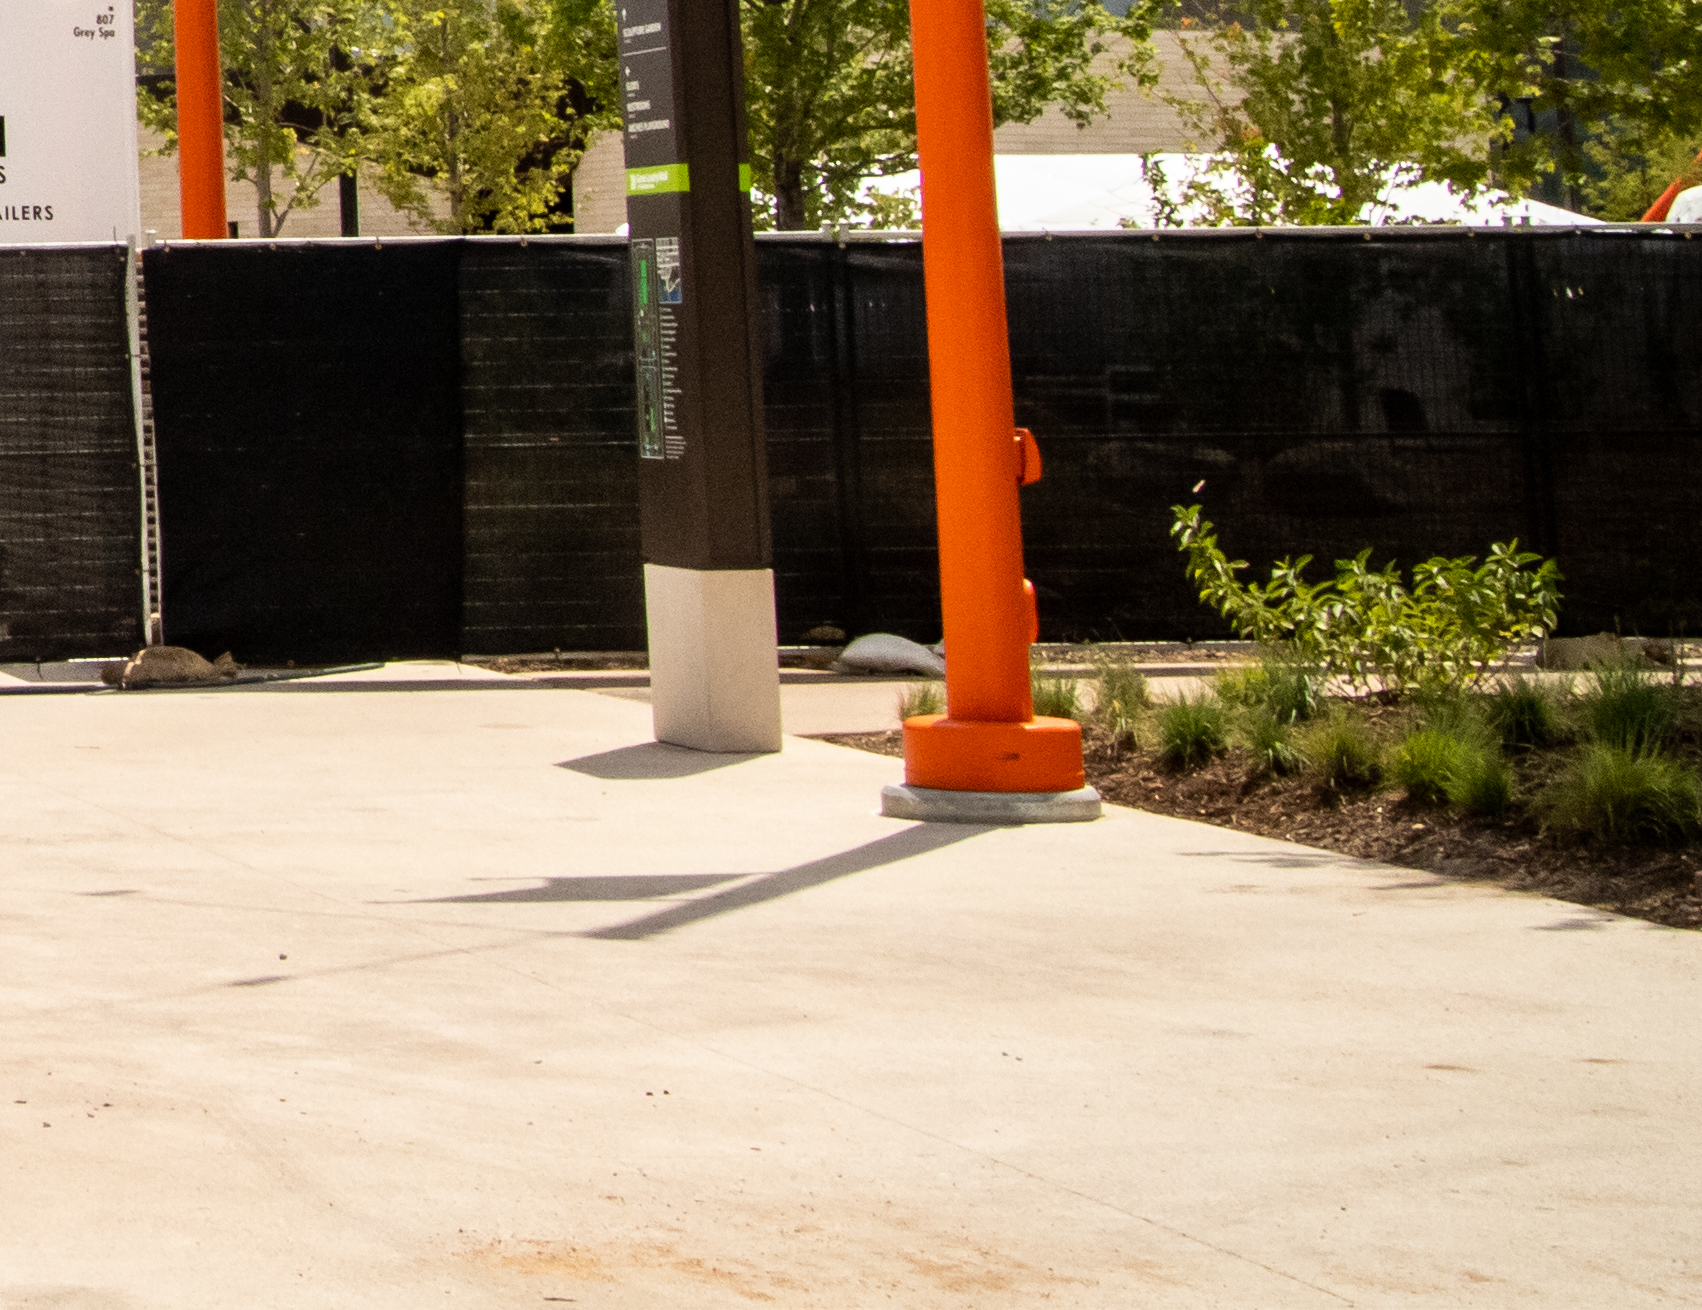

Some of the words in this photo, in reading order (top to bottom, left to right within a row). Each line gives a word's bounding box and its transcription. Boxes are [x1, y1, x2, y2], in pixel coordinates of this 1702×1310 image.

[96, 14, 115, 25] 807
[73, 26, 95, 40] Grey
[98, 27, 116, 40] Spa
